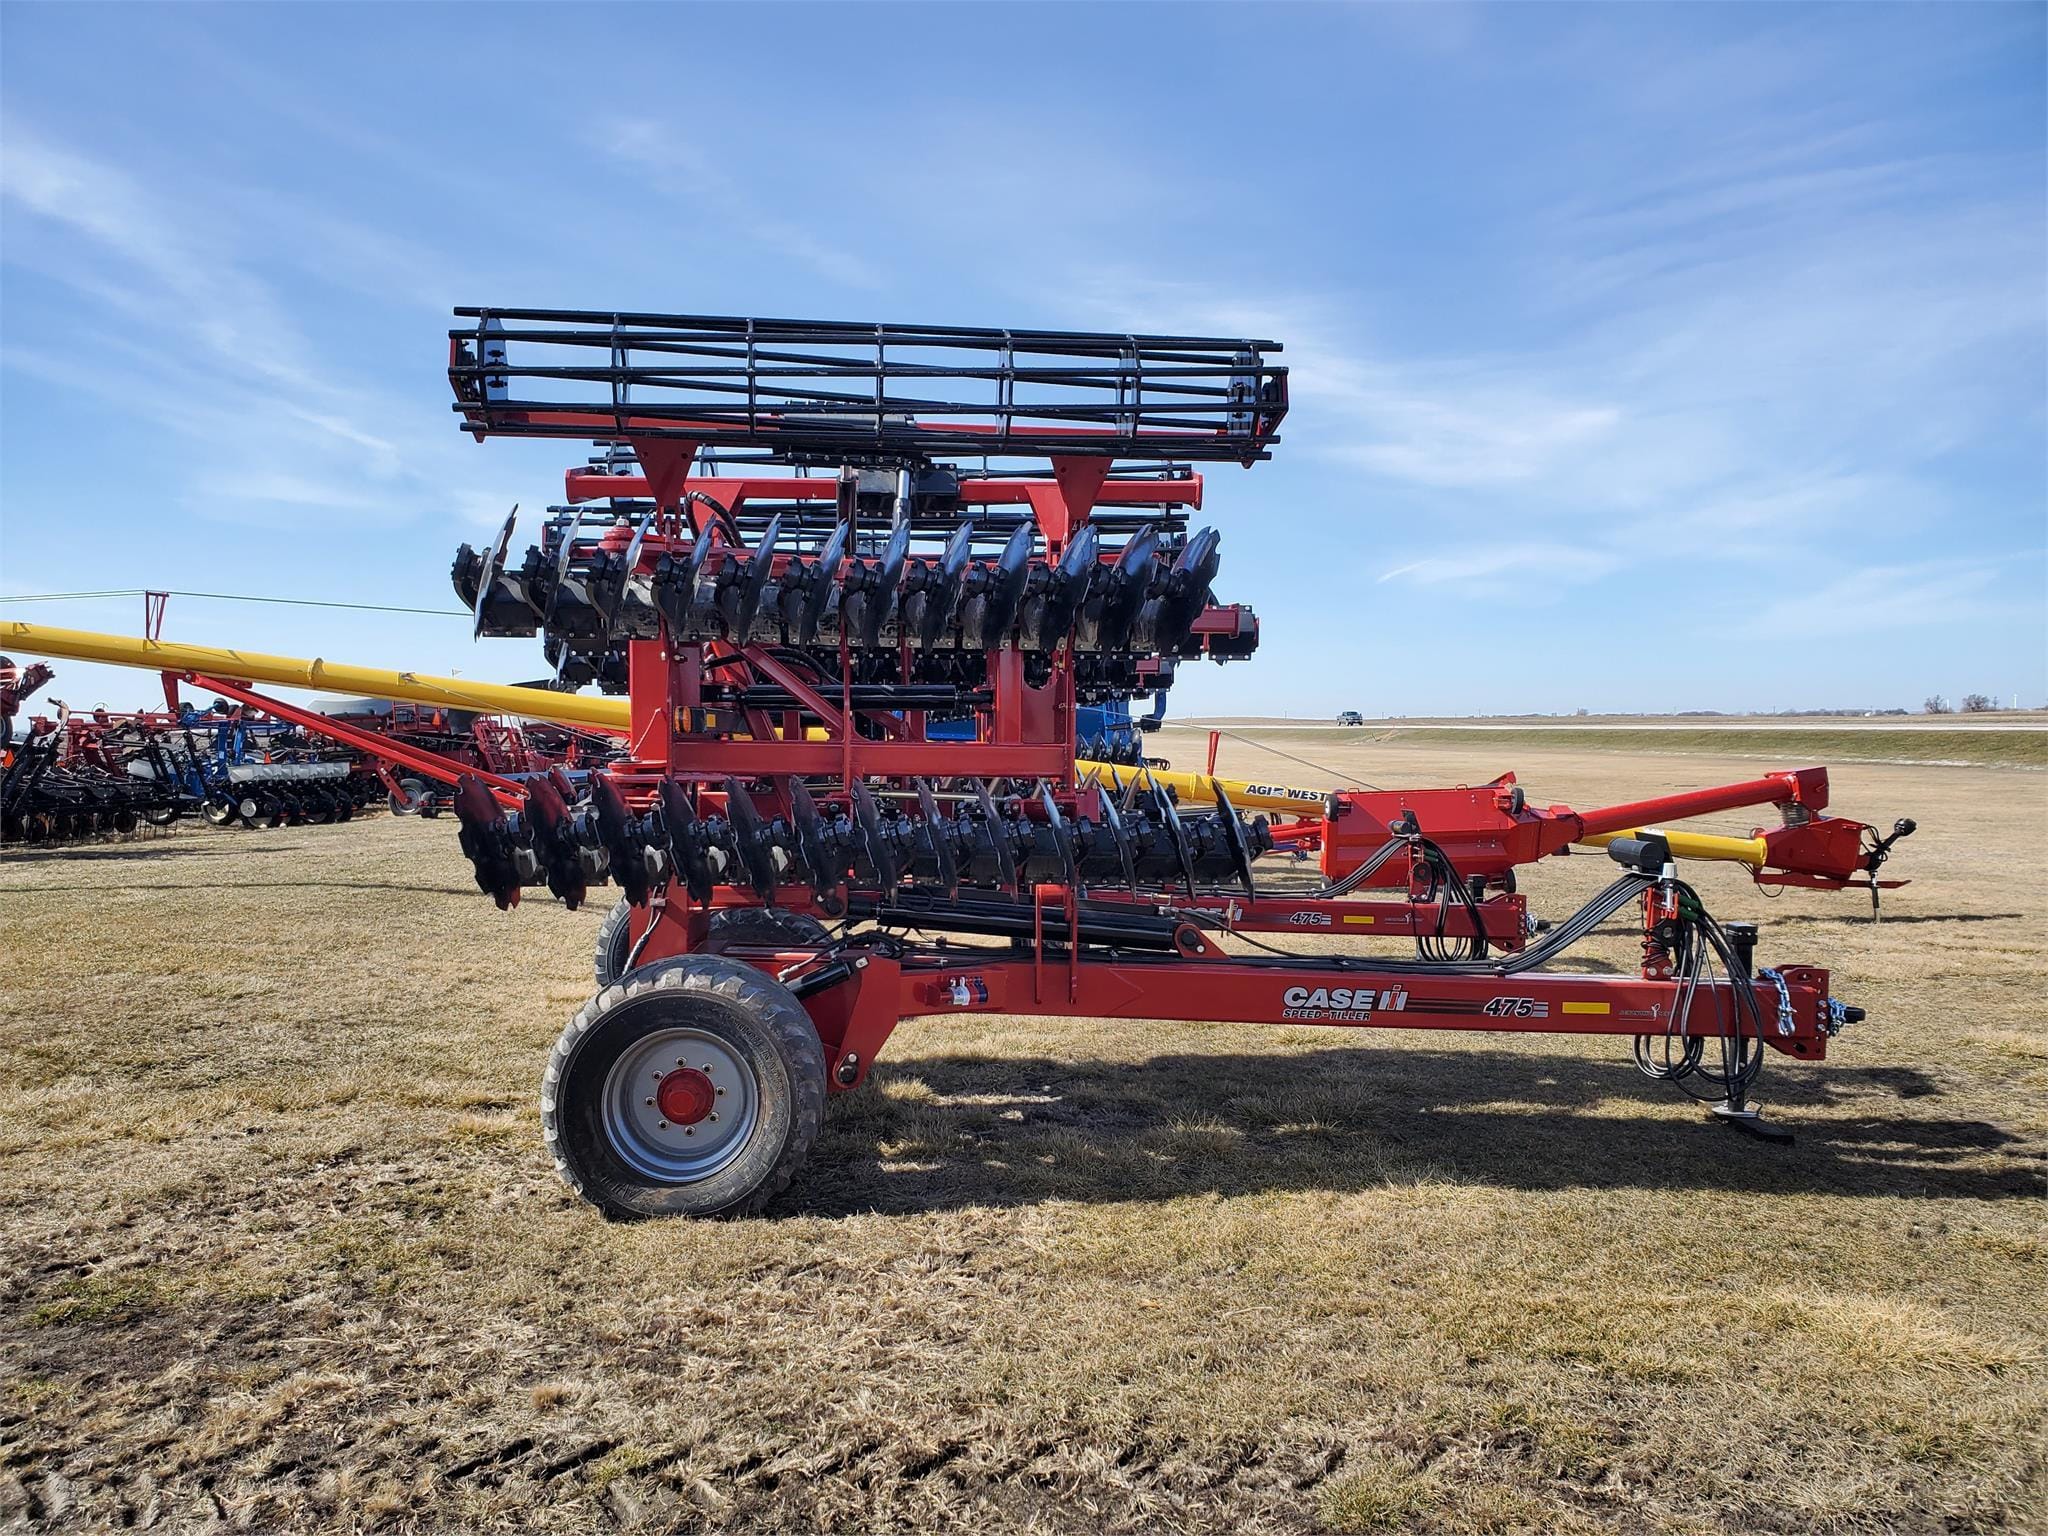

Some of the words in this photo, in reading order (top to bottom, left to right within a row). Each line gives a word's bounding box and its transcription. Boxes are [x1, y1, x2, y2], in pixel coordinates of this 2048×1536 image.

[1245, 784, 1273, 796] AGI
[1289, 911, 1322, 926] 475
[1283, 986, 1377, 1010] CASE
[1283, 1008, 1371, 1021] SPEED-TILLER
[1483, 997, 1535, 1017] 475
